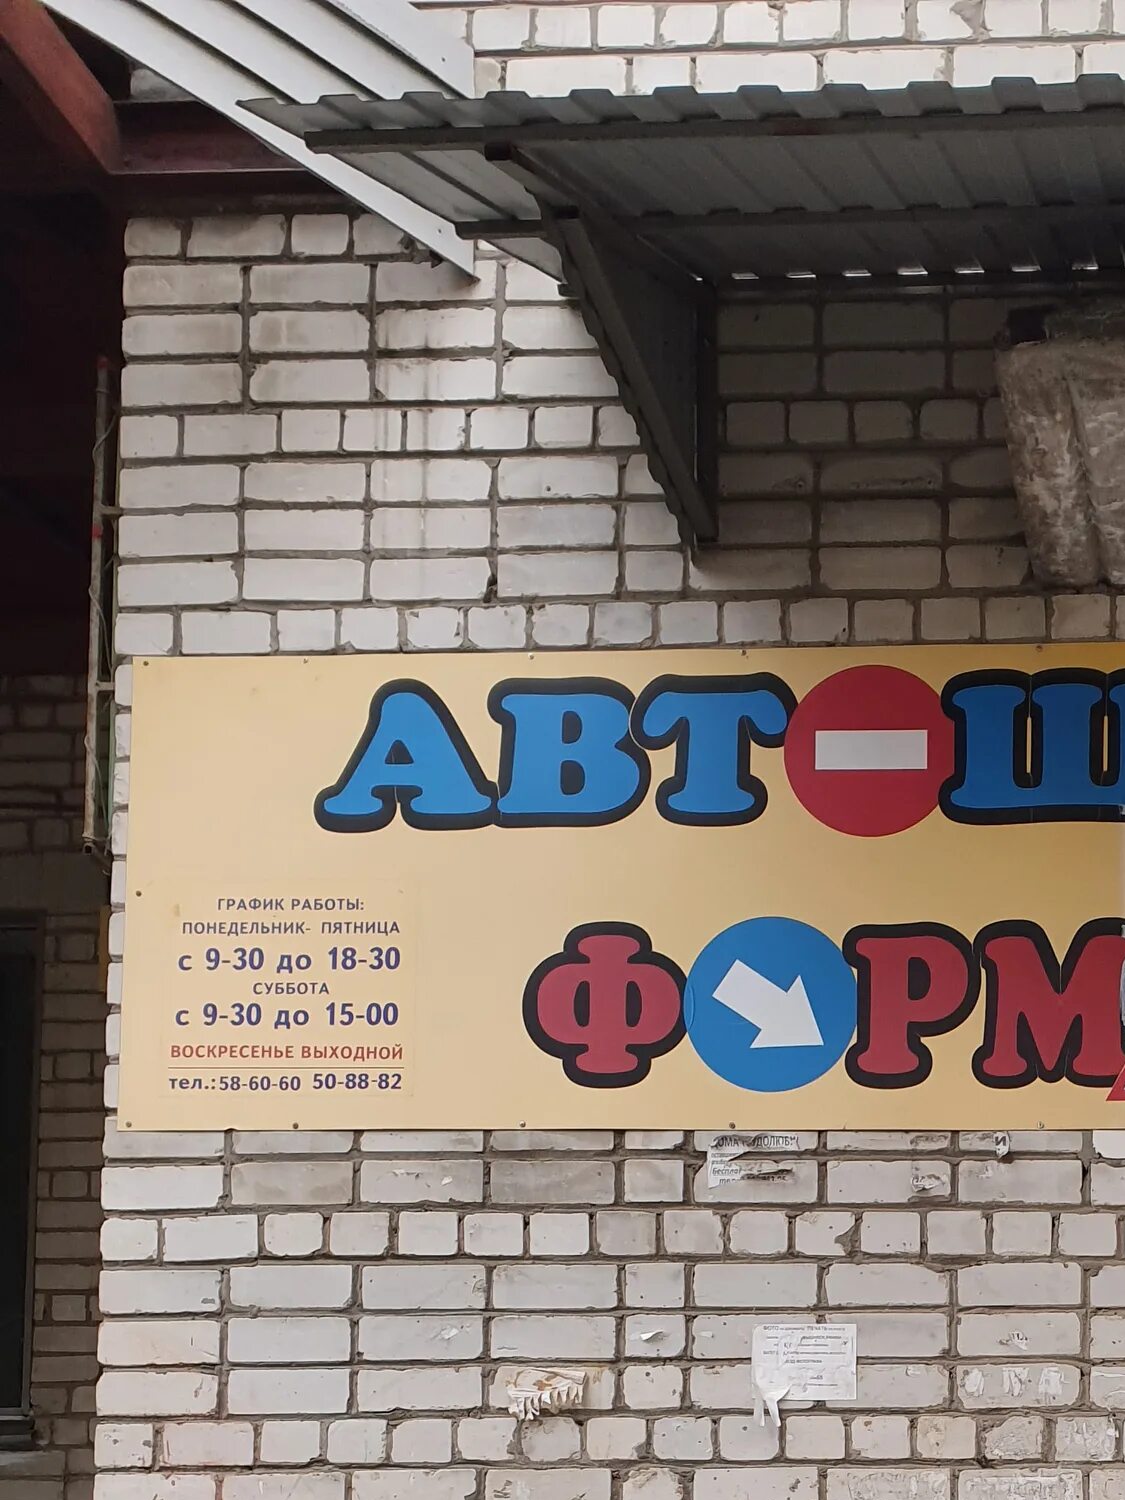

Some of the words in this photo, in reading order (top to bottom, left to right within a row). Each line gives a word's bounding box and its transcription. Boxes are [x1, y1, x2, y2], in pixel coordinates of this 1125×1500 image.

[217, 897, 284, 911] ГРАФИК
[290, 897, 365, 911] РАБОТЫ:
[321, 921, 401, 935] ПЯТНИЦА
[178, 953, 193, 971] с
[205, 947, 264, 971] 9-30
[276, 953, 312, 974] до
[327, 946, 401, 971] 18-30
[252, 981, 330, 995] СУББОТА
[175, 1009, 190, 1026] с
[202, 1002, 262, 1026] 9-30
[273, 1009, 310, 1029] до
[325, 1001, 399, 1026] 15-00
[170, 1044, 295, 1059] ВОСКРЕСЕНЬЕ
[301, 1043, 404, 1061] ВЫХОДНОЙ
[312, 1073, 402, 1090] 50-88-82
